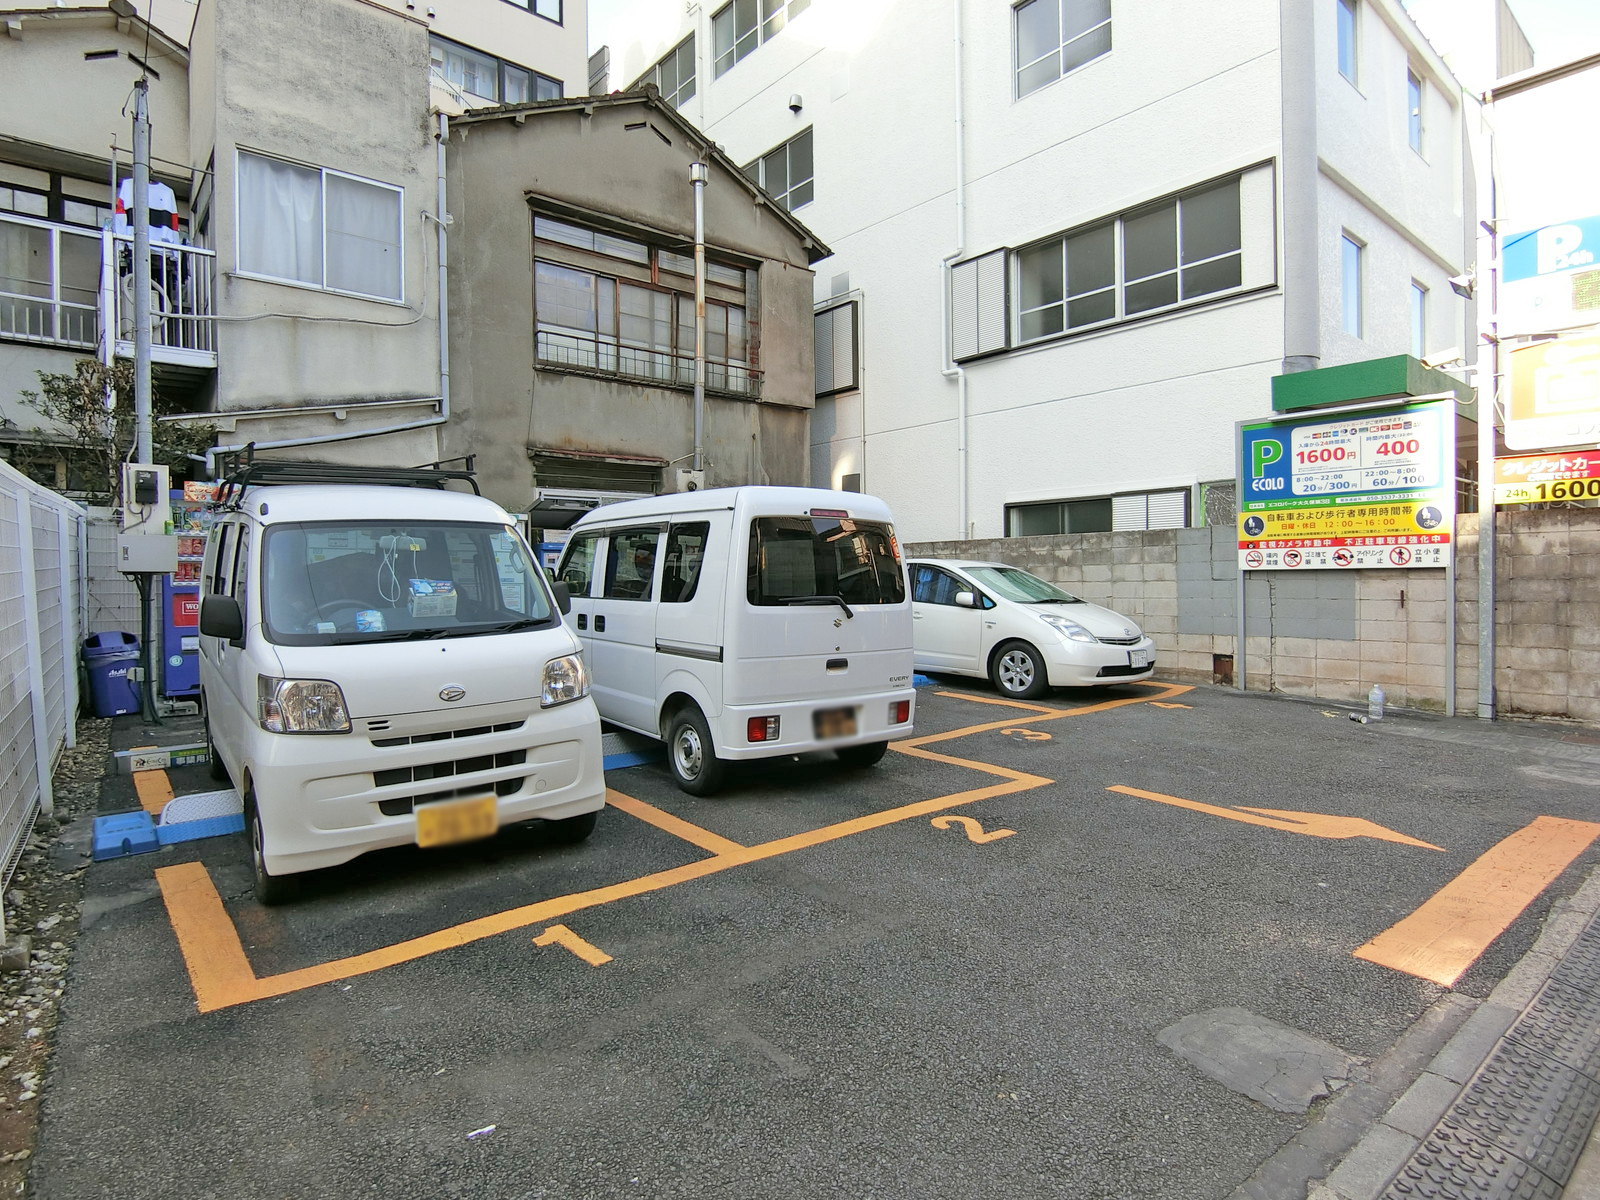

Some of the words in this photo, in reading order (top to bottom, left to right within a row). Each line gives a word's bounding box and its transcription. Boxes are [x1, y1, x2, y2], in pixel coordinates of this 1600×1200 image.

[1376, 439, 1420, 456] 400
[1252, 438, 1283, 479] P
[1252, 477, 1285, 491] ECOLO
[1506, 488, 1528, 497] 24h
[1536, 480, 1600, 499] 1600
[1267, 506, 1412, 522] 自転車および歩行者専用時間帯
[1260, 539, 1331, 548] 監視カメラ作動中
[1344, 535, 1441, 545] 不正駐車取締強化中
[108, 667, 127, 677] Asahi
[1000, 726, 1052, 741] 3
[931, 815, 1017, 845] 2
[532, 924, 613, 966] 1
